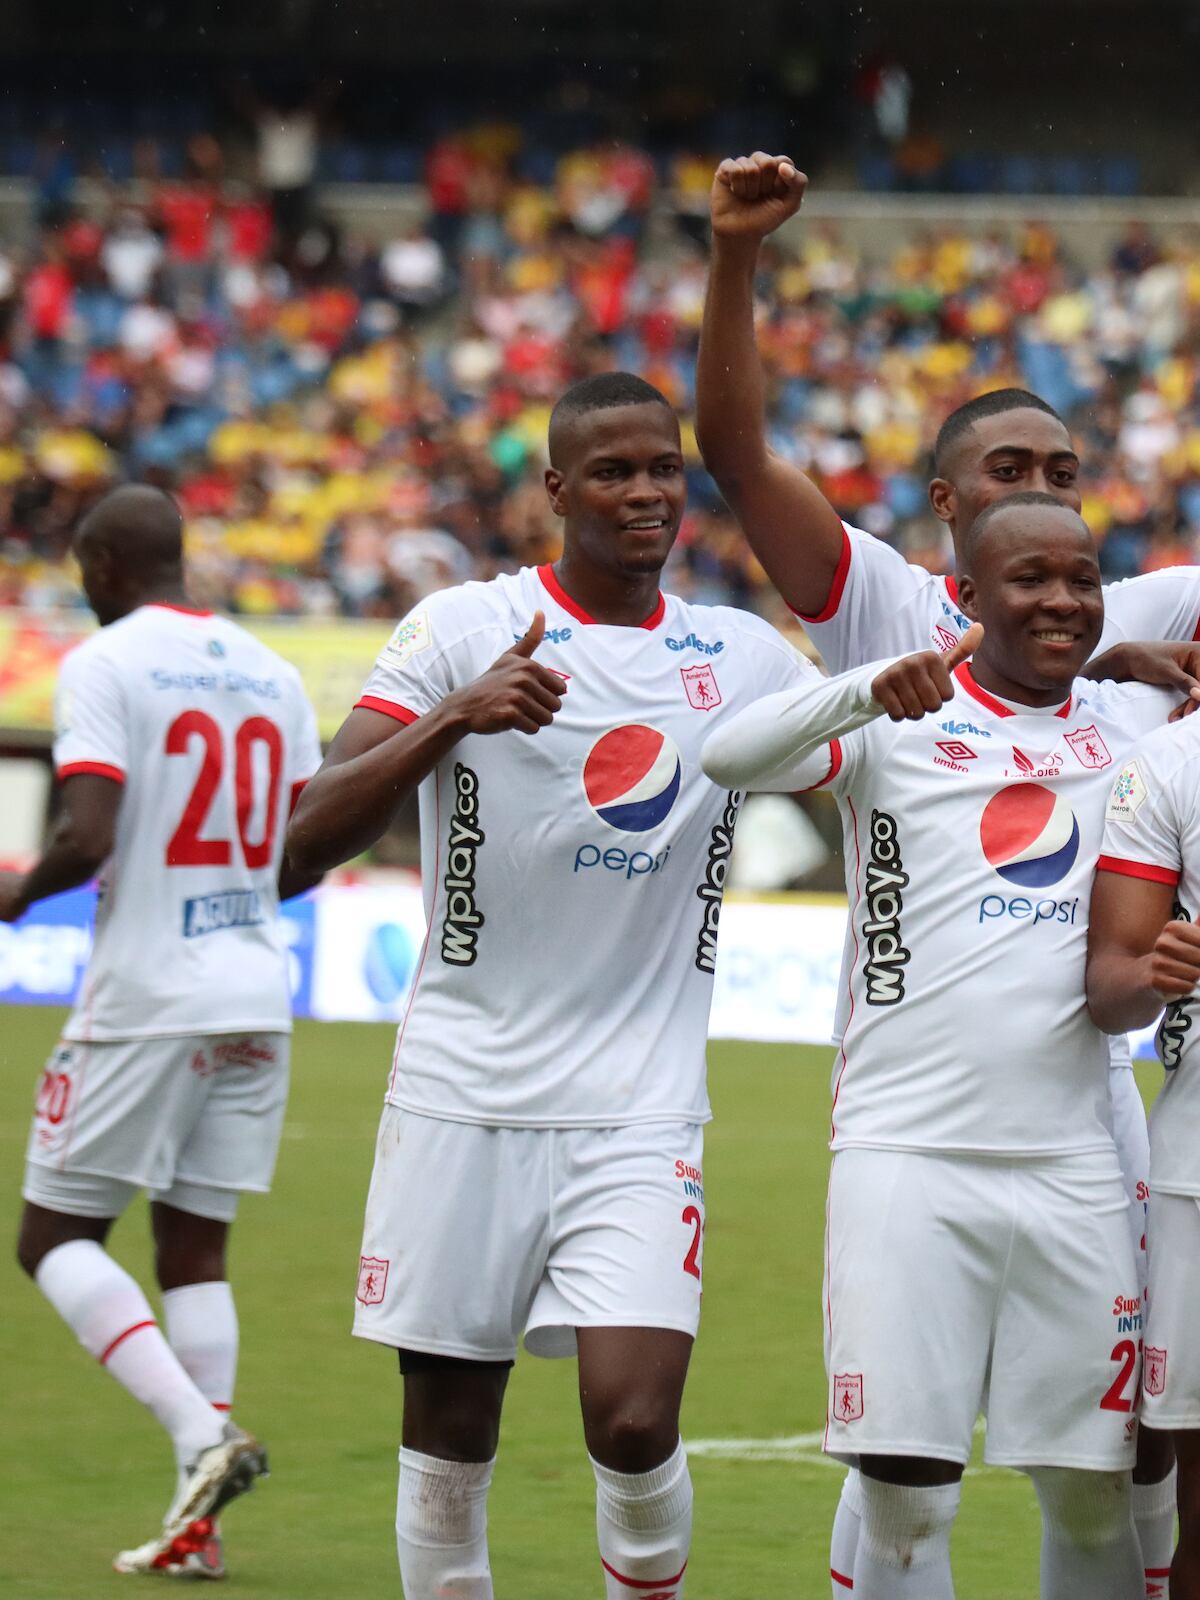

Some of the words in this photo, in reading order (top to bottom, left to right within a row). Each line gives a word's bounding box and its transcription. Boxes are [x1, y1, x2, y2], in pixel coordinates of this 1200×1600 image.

[937, 719, 992, 739] llette
[1071, 732, 1096, 745] América
[933, 756, 969, 773] umbro
[165, 710, 284, 870] 20
[441, 763, 485, 966] wplay.co
[573, 844, 671, 880] pepsi
[864, 808, 911, 1006] wplay.co
[979, 895, 1079, 925] pepsi
[682, 1205, 704, 1281] 2
